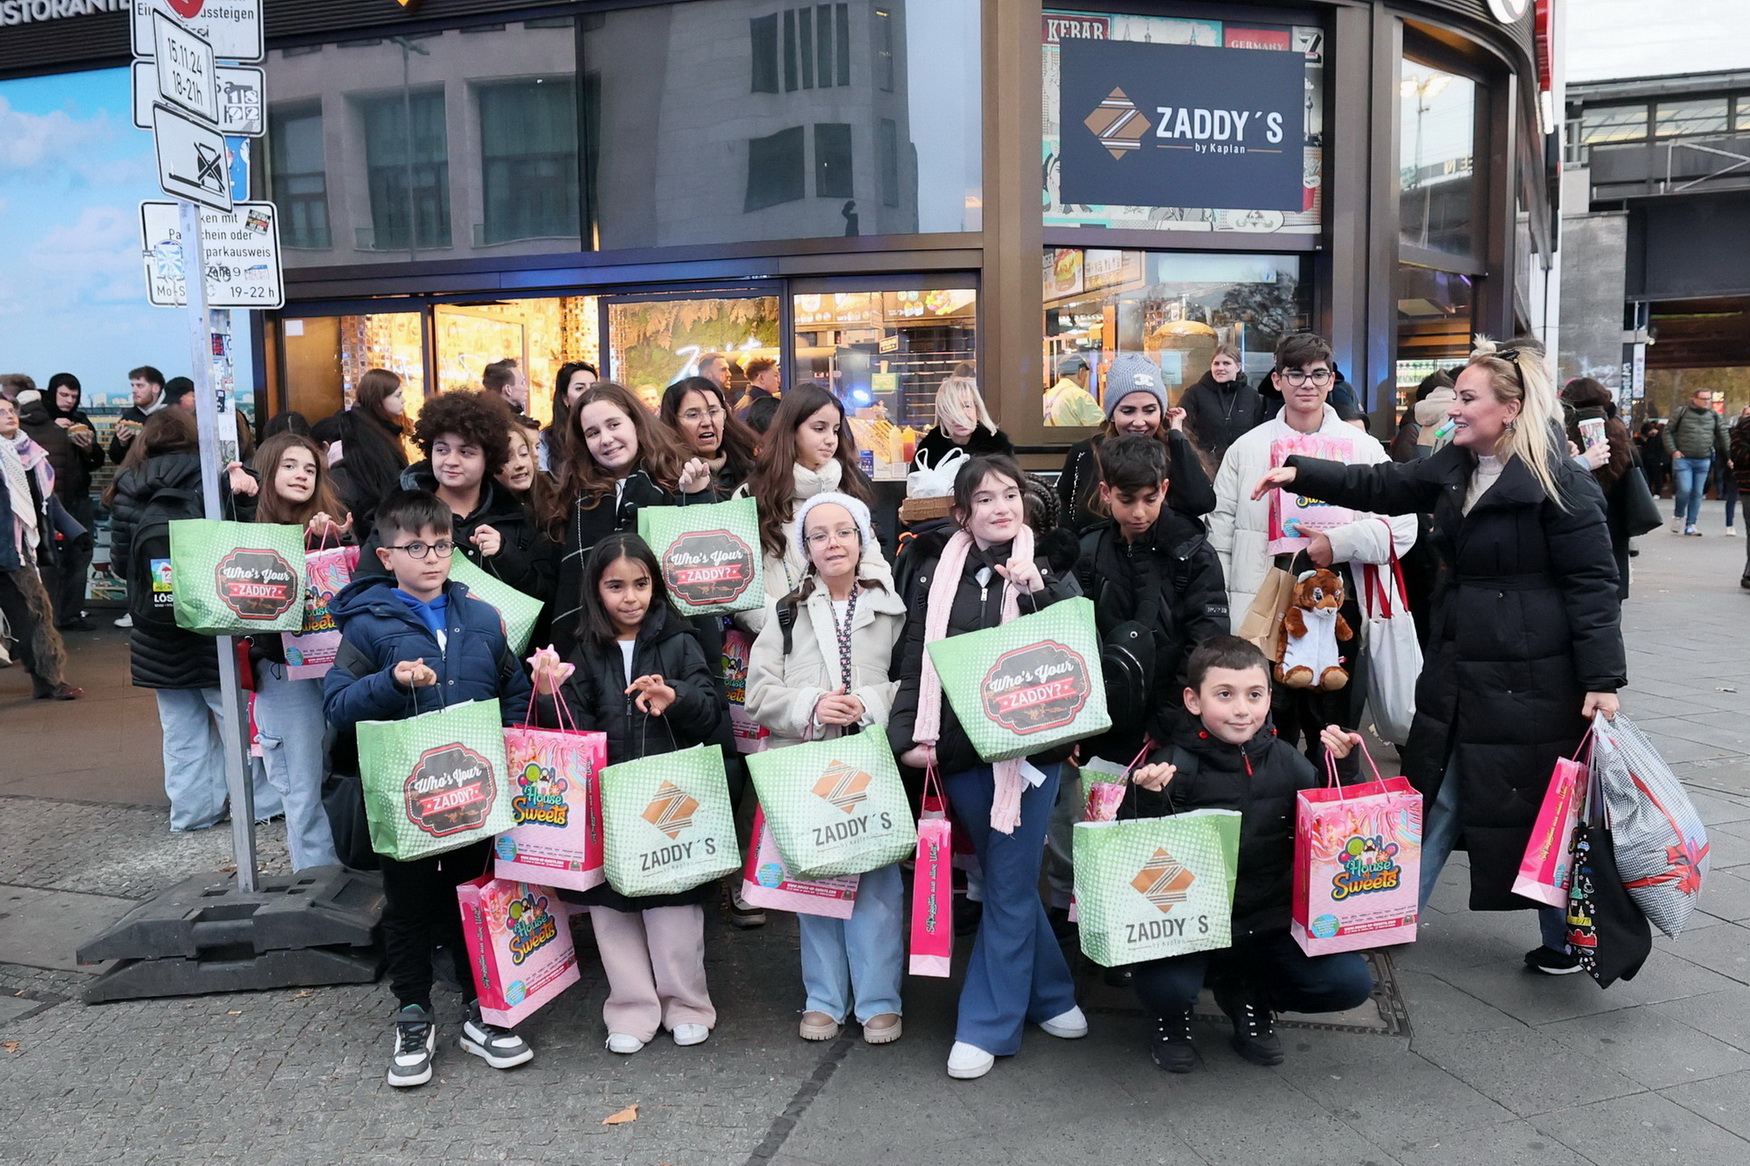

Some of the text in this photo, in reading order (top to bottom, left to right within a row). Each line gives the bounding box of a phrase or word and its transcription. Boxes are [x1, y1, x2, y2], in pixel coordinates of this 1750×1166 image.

[200, 6, 254, 22] ussteigen
[1230, 39, 1284, 51] GERMANY
[167, 37, 203, 78] 15.11.24
[172, 70, 204, 107] 18-21h
[1156, 105, 1284, 144] ZADDY´S
[1194, 142, 1246, 155] by Kaplan
[221, 212, 238, 223] mit
[230, 229, 253, 240] oder
[205, 246, 271, 260] parkausweis
[232, 267, 241, 277] 9
[230, 286, 265, 298] 19-22
[268, 286, 275, 298] h
[671, 550, 744, 567] Who's Your
[222, 566, 291, 584] Who's Your
[686, 567, 731, 581] ZADDY?
[239, 584, 277, 597] ZADDY?
[989, 660, 1075, 692] Who's Your
[1008, 683, 1062, 708] ZADDY?
[414, 766, 483, 794] Who's Your
[433, 787, 475, 811] ZADDY?
[524, 785, 562, 805] House
[512, 797, 568, 825] Sweets
[812, 811, 893, 846] ZADDY´S
[640, 837, 717, 872] ZADDY´S
[1346, 858, 1392, 877] House
[1332, 867, 1399, 899] Sweets
[514, 914, 547, 937] House
[1125, 915, 1209, 944] ZADDY´S
[510, 921, 555, 965] Sweets
